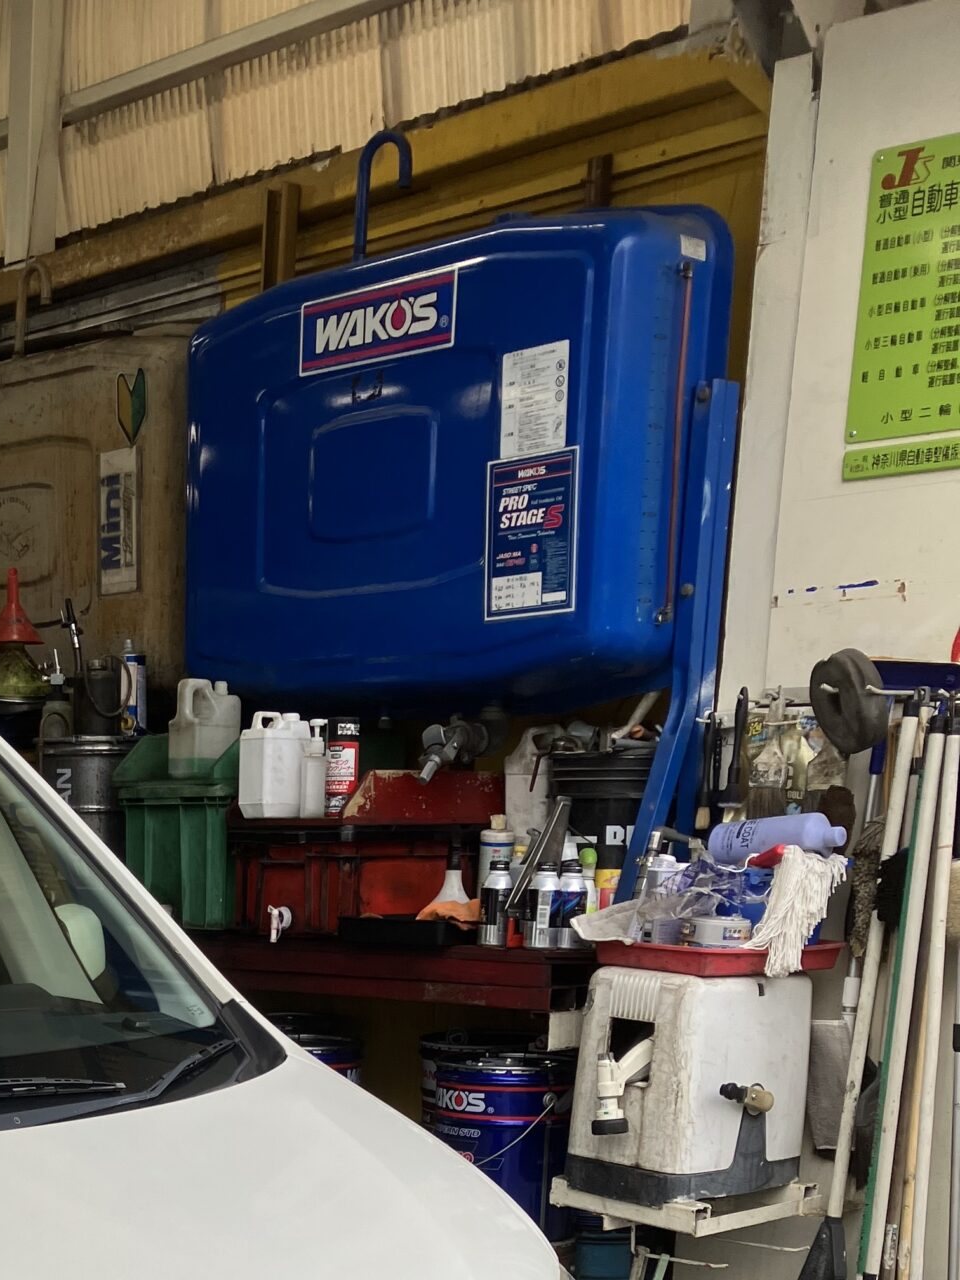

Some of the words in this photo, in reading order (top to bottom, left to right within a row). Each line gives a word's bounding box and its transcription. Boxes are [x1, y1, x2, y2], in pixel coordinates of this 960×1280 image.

[942, 155, 960, 170] 関
[881, 403, 960, 425] 小型二輪
[498, 493, 529, 513] PRO
[500, 507, 546, 529] STAGE
